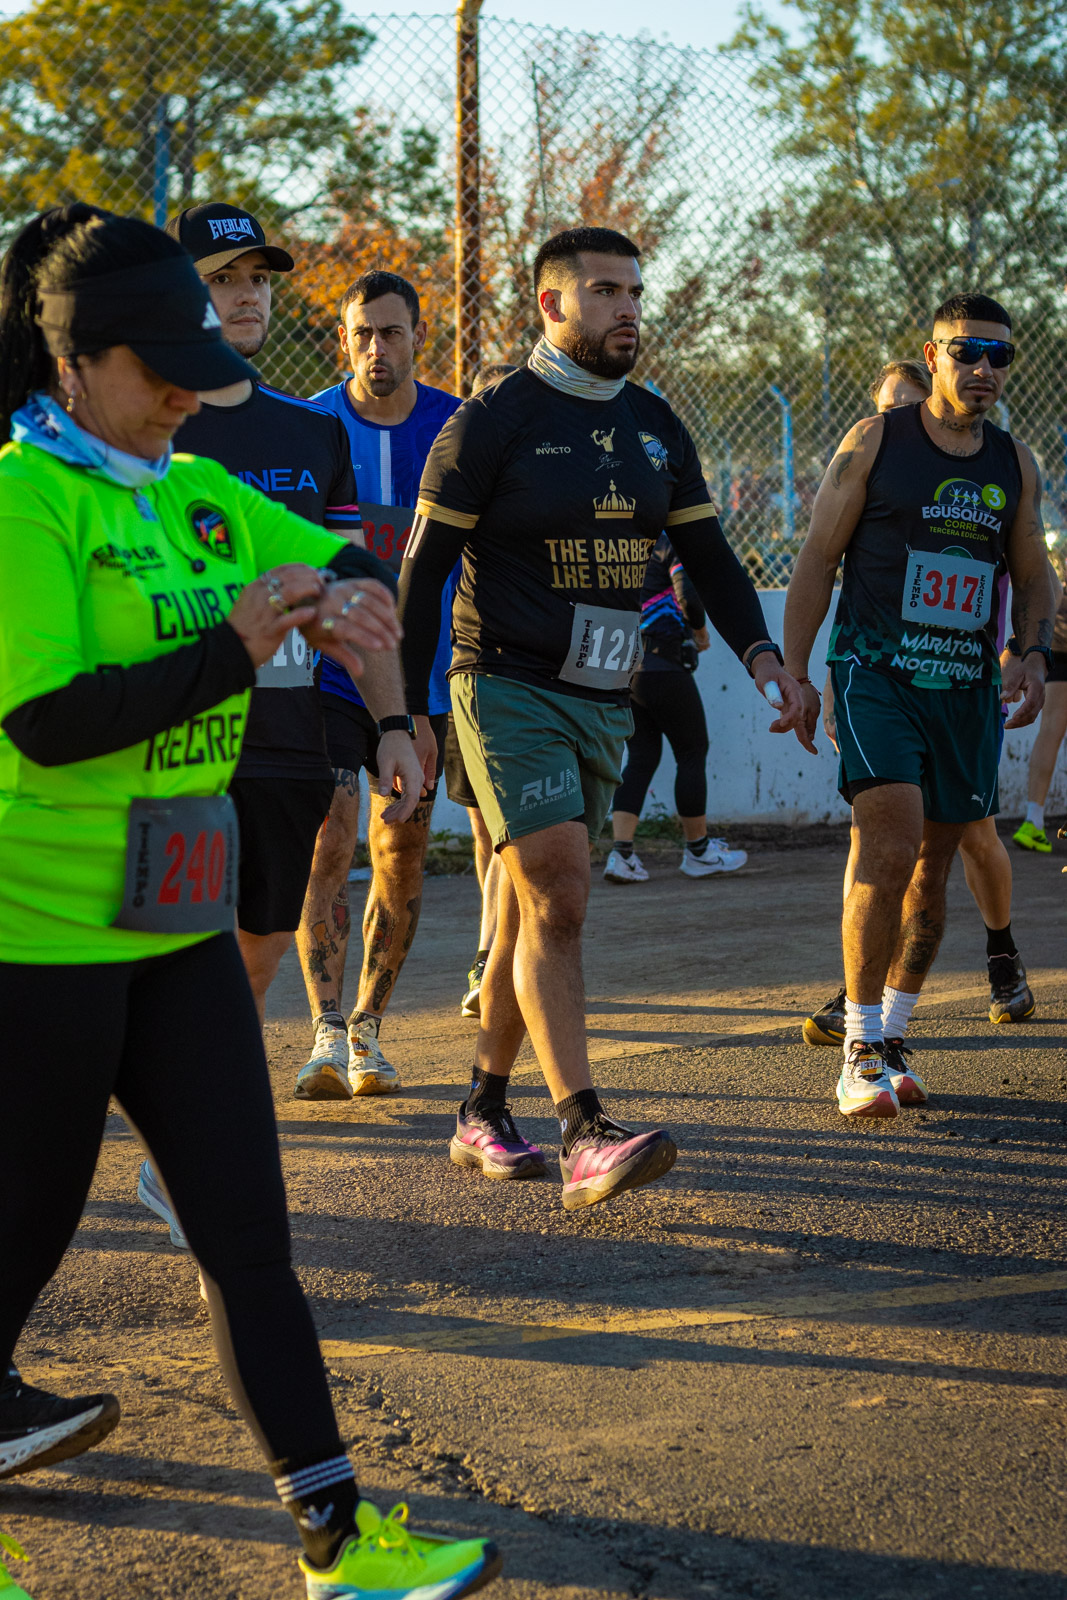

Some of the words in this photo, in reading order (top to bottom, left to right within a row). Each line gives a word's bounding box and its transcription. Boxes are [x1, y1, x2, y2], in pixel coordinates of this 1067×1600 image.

[207, 218, 257, 240] EVERLAST
[536, 446, 572, 455] INVICTO
[988, 487, 1001, 507] 3
[921, 505, 1003, 534] EGUSQUIZA
[929, 526, 960, 537] TERCERA
[944, 519, 979, 532] CORRE
[544, 538, 589, 563] THE
[909, 564, 924, 608] TIEMPO
[922, 570, 979, 613] 317
[974, 574, 987, 618] EXACTO
[151, 587, 226, 641] CLUB
[575, 619, 593, 669] TIEMPO
[586, 625, 636, 672] 121
[901, 631, 983, 658] MARATÓN
[890, 652, 985, 681] NOCTURNA
[132, 821, 151, 908] TIEMPO
[157, 830, 227, 904] 240
[864, 1061, 878, 1069] 317
